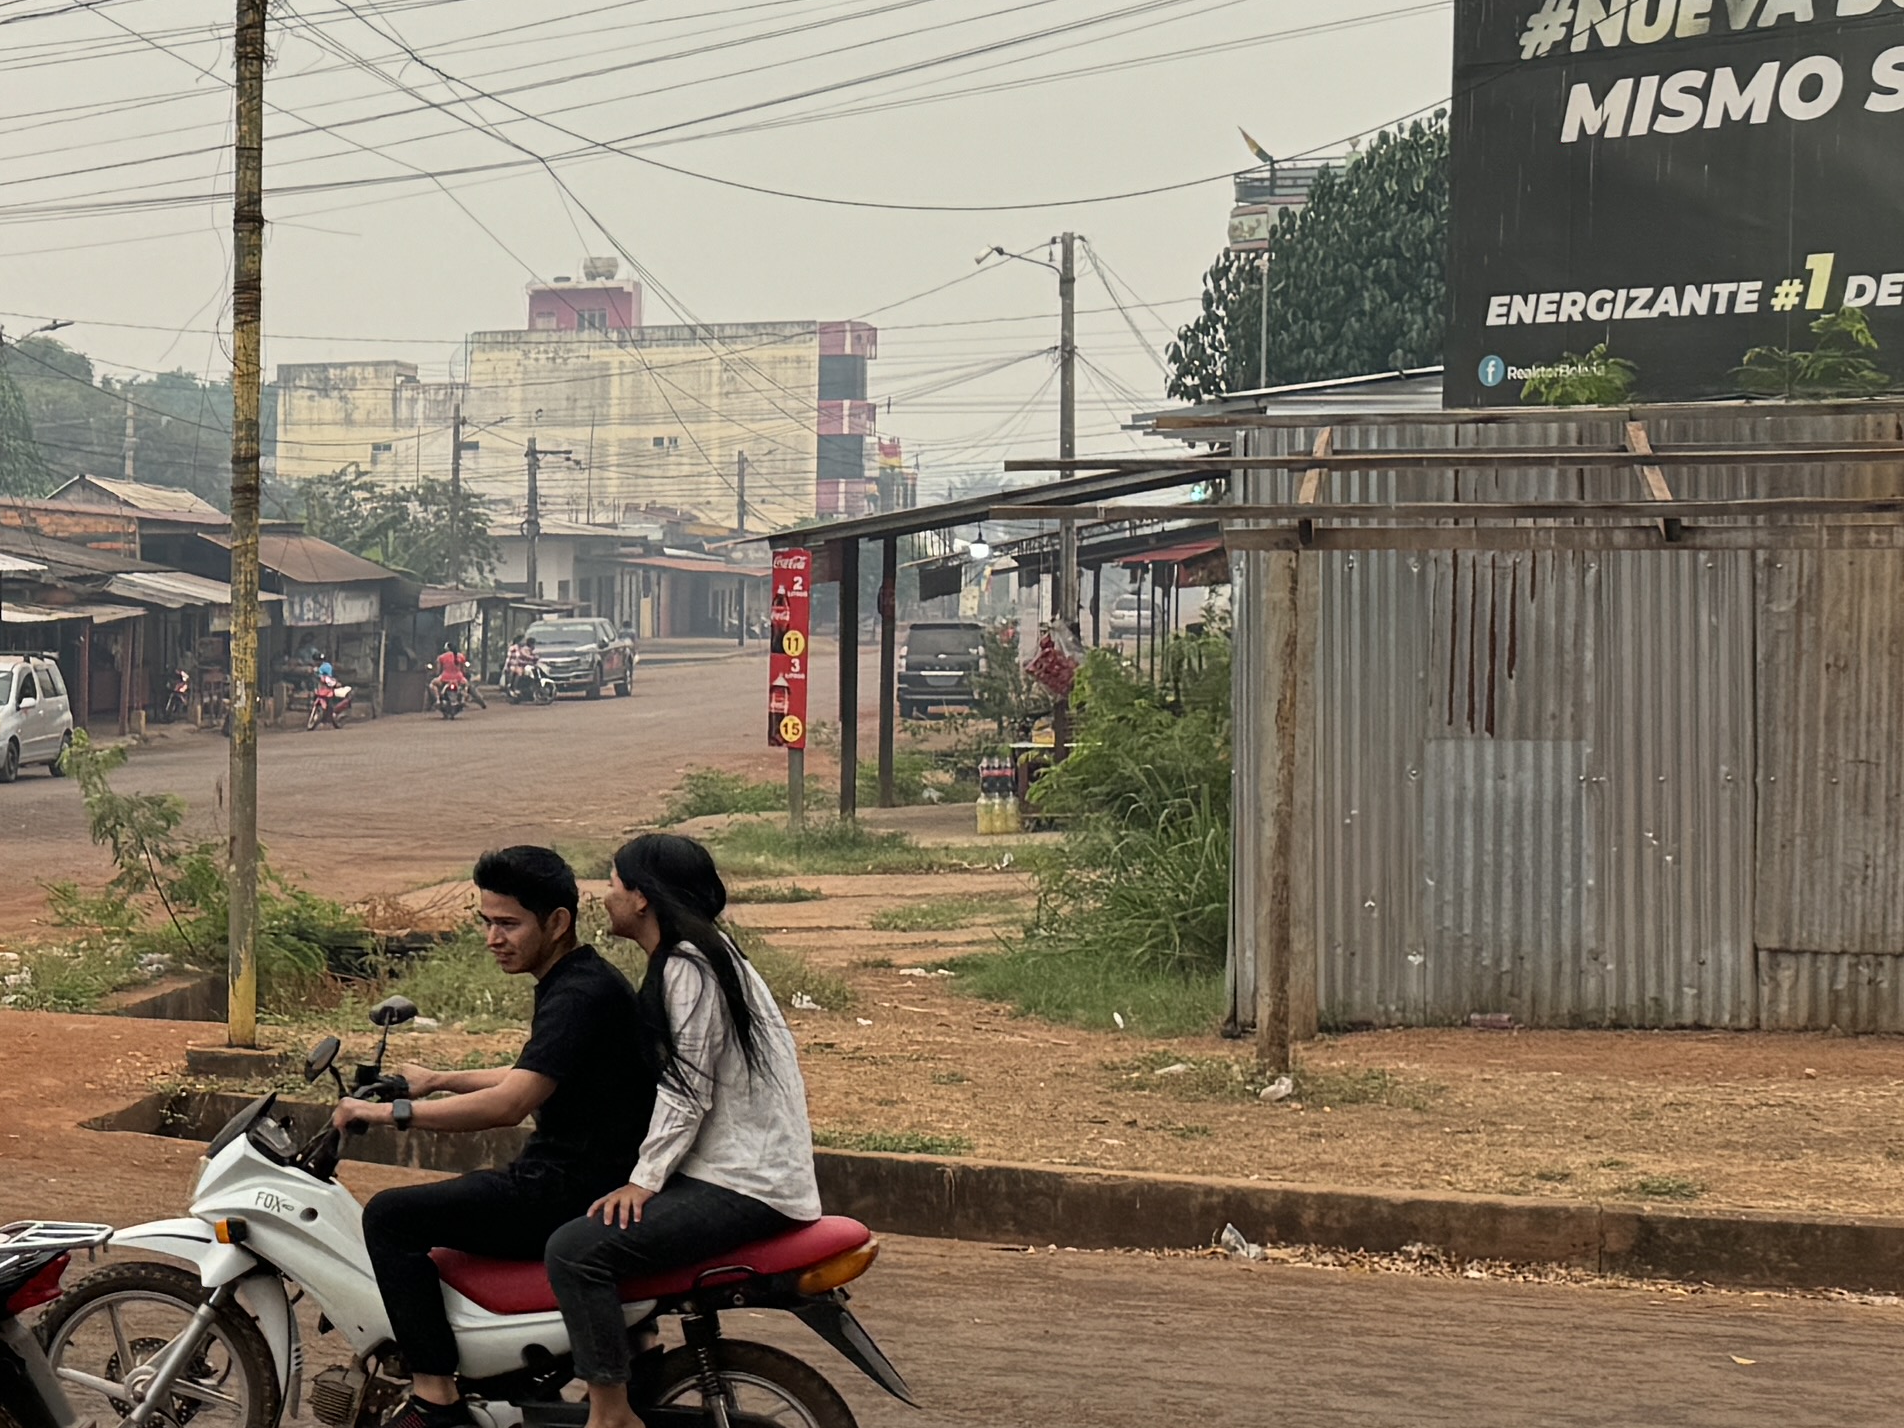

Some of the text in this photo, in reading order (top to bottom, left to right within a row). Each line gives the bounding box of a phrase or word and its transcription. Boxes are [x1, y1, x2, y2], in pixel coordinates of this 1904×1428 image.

[1560, 55, 1844, 143] MISMO
[1486, 281, 1763, 327] ENERGIZANTE
[1770, 252, 1835, 312] #1
[793, 576, 803, 591] 2
[786, 637, 800, 652] 11
[790, 658, 800, 672] 3
[783, 723, 800, 736] 15
[255, 1191, 287, 1213] FOX
